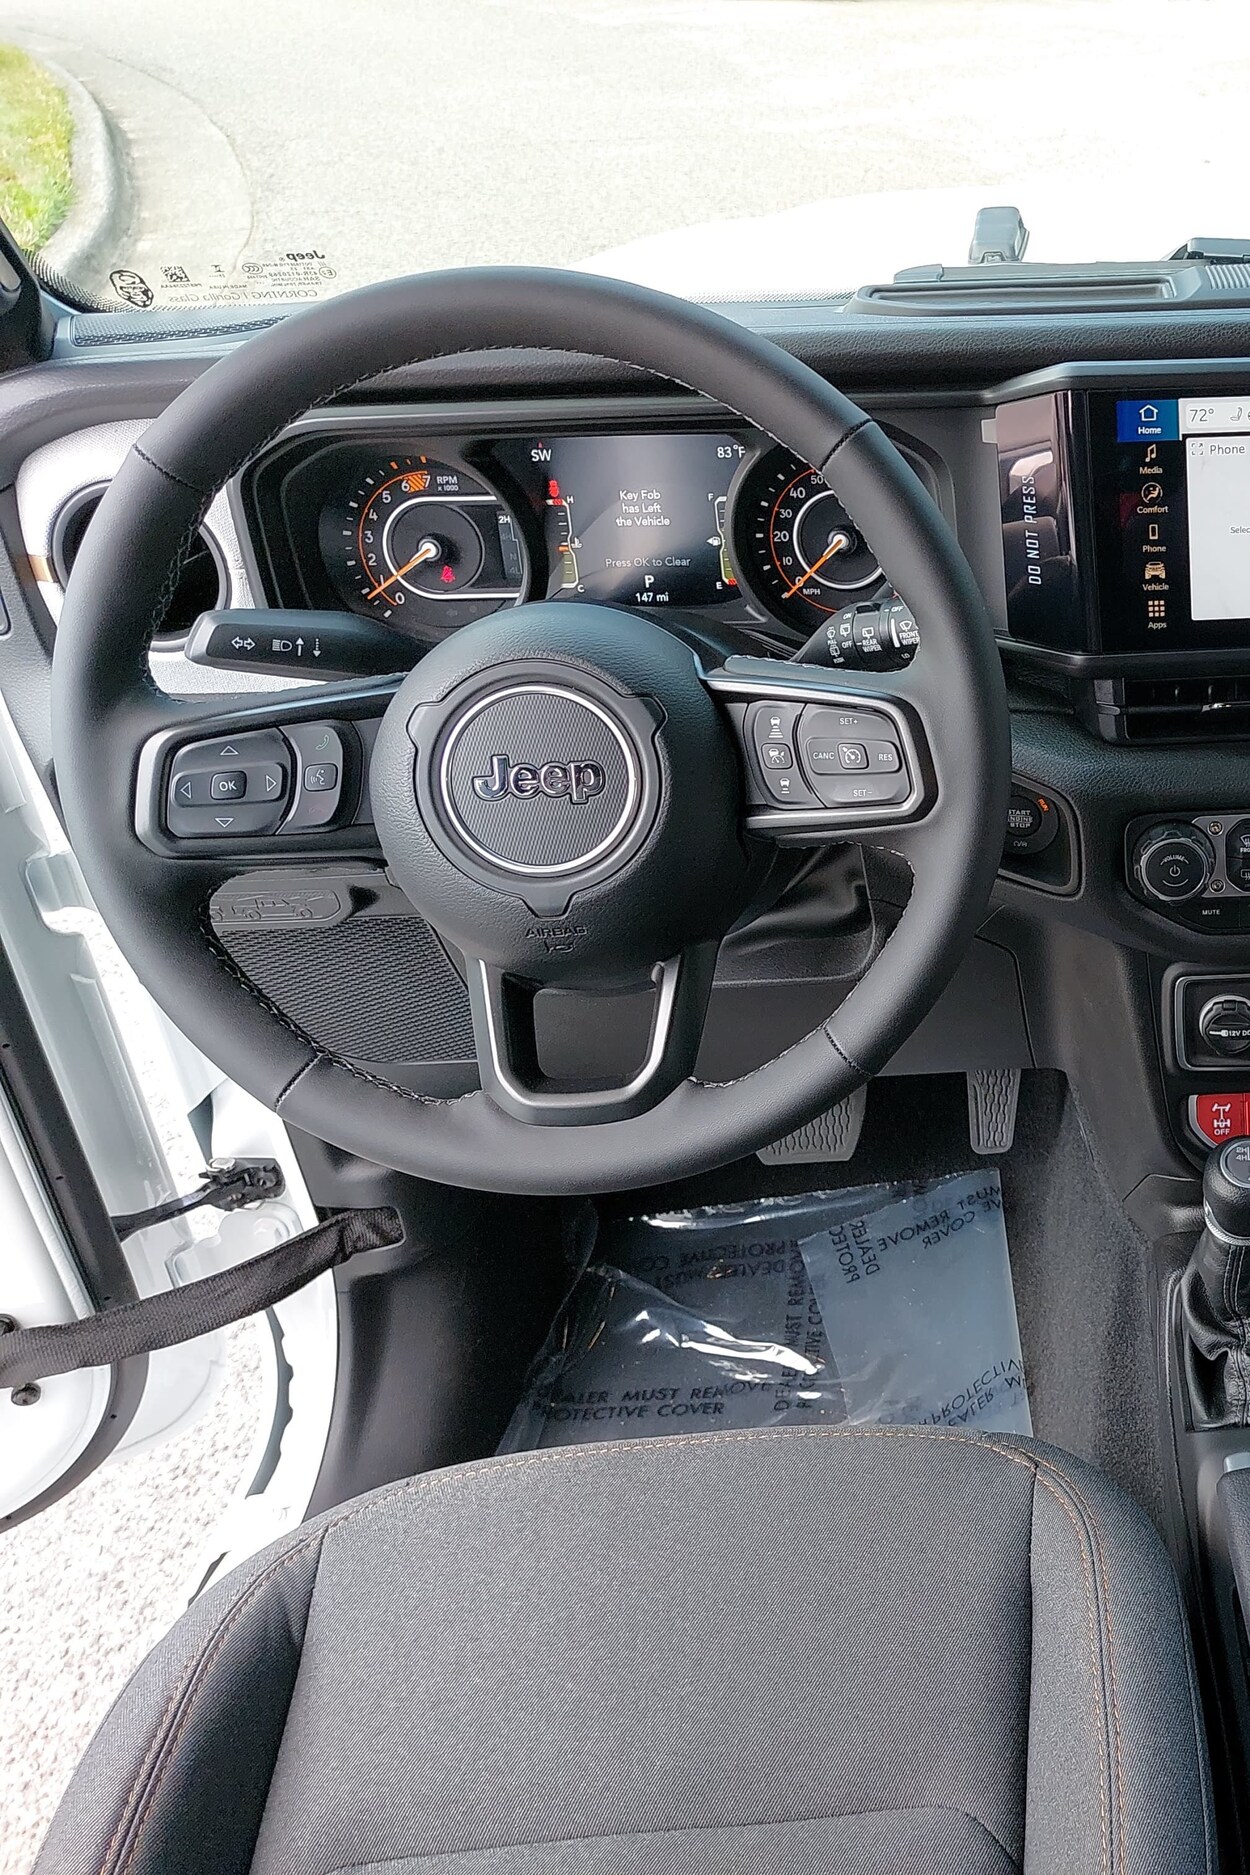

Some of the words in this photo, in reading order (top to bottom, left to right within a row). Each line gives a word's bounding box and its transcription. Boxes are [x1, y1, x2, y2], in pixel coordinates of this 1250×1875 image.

[1189, 408, 1214, 422] 72°
[1138, 426, 1162, 434] Home
[530, 449, 551, 462] SW
[1209, 444, 1246, 456] Phone
[1139, 466, 1162, 474] Media
[422, 476, 430, 488] 7
[436, 476, 458, 484] RPM
[810, 474, 824, 484] 50
[401, 479, 410, 492] 6
[382, 490, 392, 504] 5
[620, 490, 638, 501] Key
[641, 490, 660, 500] Fob
[790, 488, 806, 499] 40
[1022, 476, 1038, 524] PRESS
[622, 504, 640, 514] has
[642, 503, 662, 514] Left
[779, 508, 792, 518] 30
[1136, 505, 1168, 514] Comfort
[369, 509, 378, 522] 4
[498, 516, 510, 524] 2H
[616, 516, 632, 526] the
[634, 516, 670, 526] Vehicle
[364, 531, 374, 543] 3
[773, 531, 789, 542] 20
[1025, 530, 1040, 558] NOT
[368, 554, 377, 566] 2
[606, 558, 631, 568] Press
[634, 558, 650, 568] OK
[652, 558, 662, 567] to
[665, 557, 690, 567] Clear
[783, 556, 792, 566] 10
[1028, 565, 1042, 584] DO
[644, 576, 654, 588] P
[716, 582, 722, 590] E
[795, 576, 804, 588] 0
[578, 584, 584, 593] C
[395, 592, 404, 604] 0
[635, 592, 654, 602] 147
[656, 592, 669, 602] mi
[1148, 622, 1167, 630] Apps
[899, 630, 919, 640] FRONT
[842, 640, 852, 648] OFF
[862, 644, 882, 652] WIPER
[473, 754, 606, 804] Jeep
[219, 780, 237, 791] OK
[1162, 854, 1186, 862] VOLUME
[526, 926, 588, 938] AIRBAG
[622, 1388, 680, 1402] MUST
[690, 1382, 772, 1399] REMOVE
[657, 1402, 724, 1417] COVER
